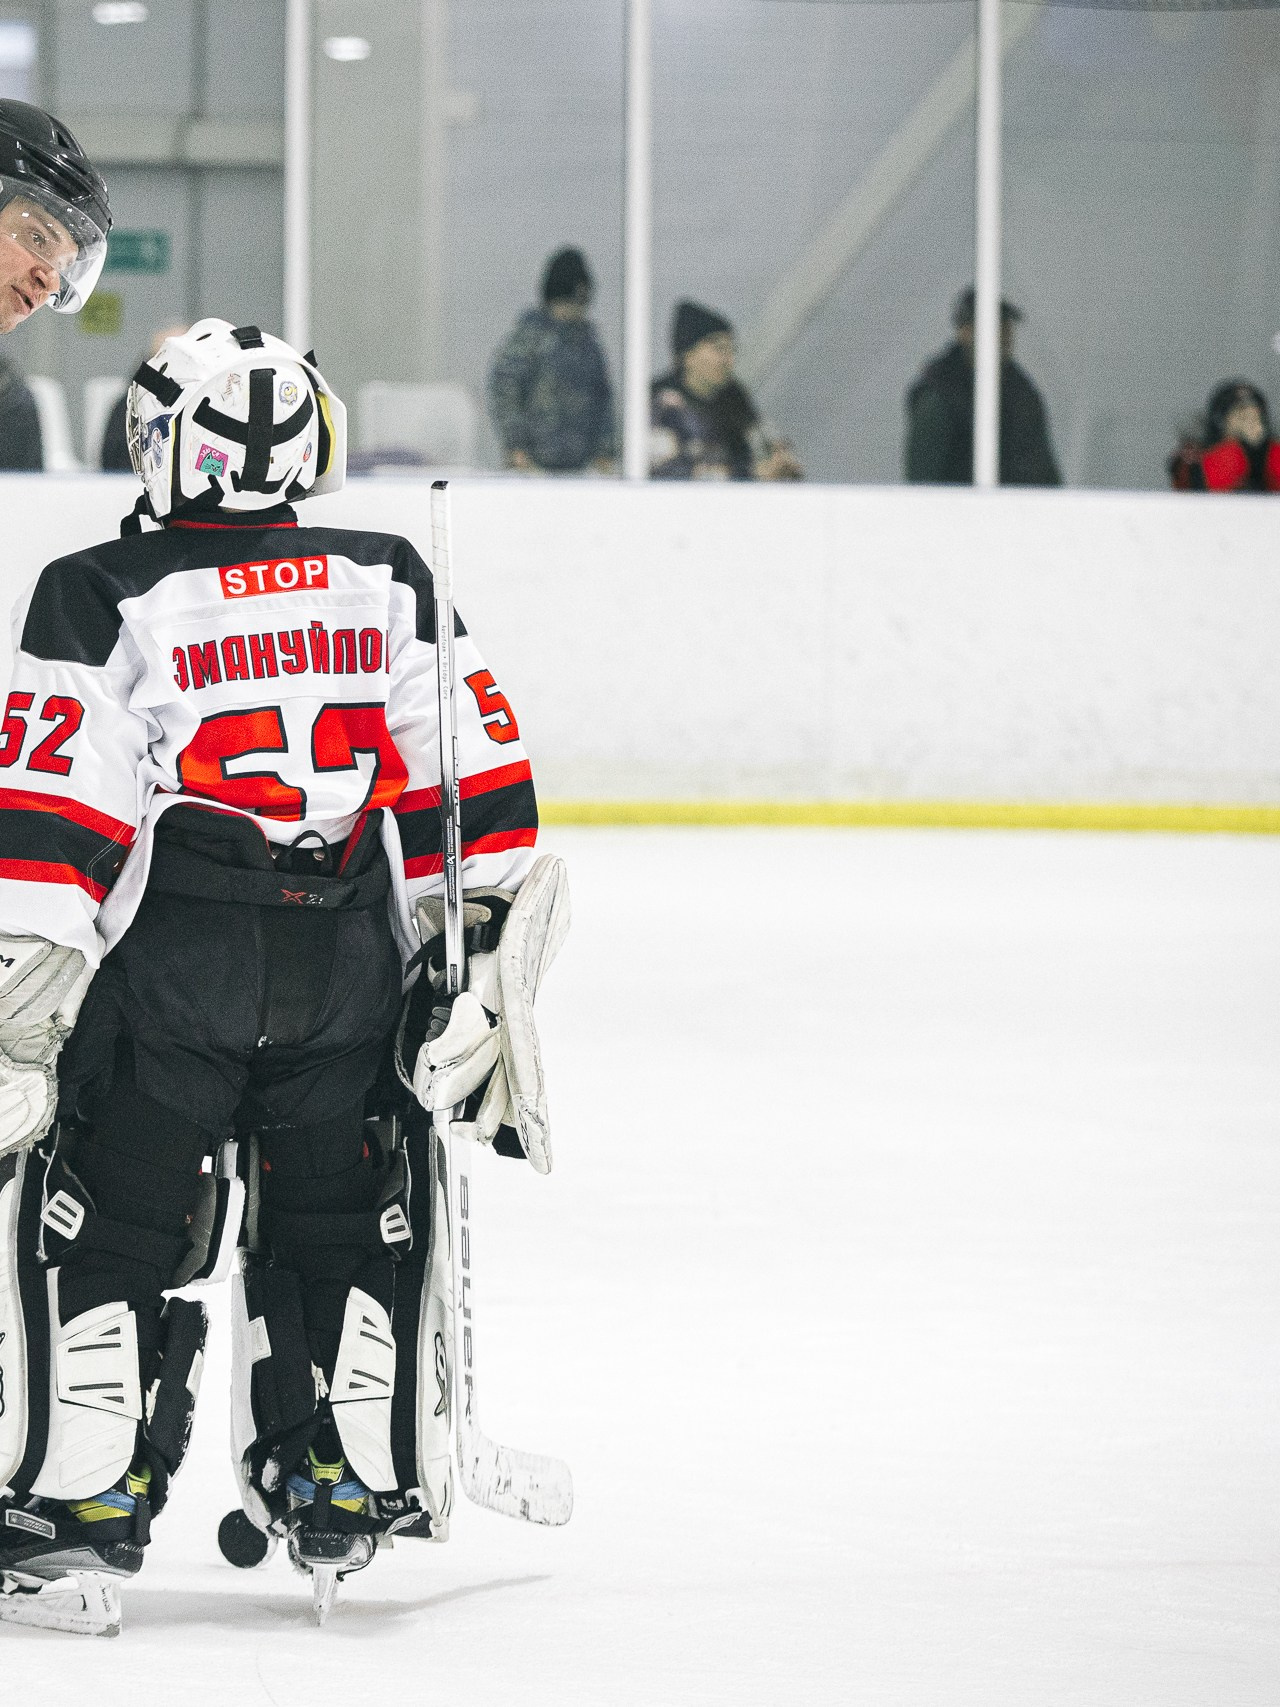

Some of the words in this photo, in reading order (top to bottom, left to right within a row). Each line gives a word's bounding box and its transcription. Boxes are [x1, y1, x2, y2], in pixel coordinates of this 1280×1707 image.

[225, 560, 324, 595] STOP
[172, 620, 390, 692] ЭМАНУЙЛО
[175, 701, 410, 822] 52
